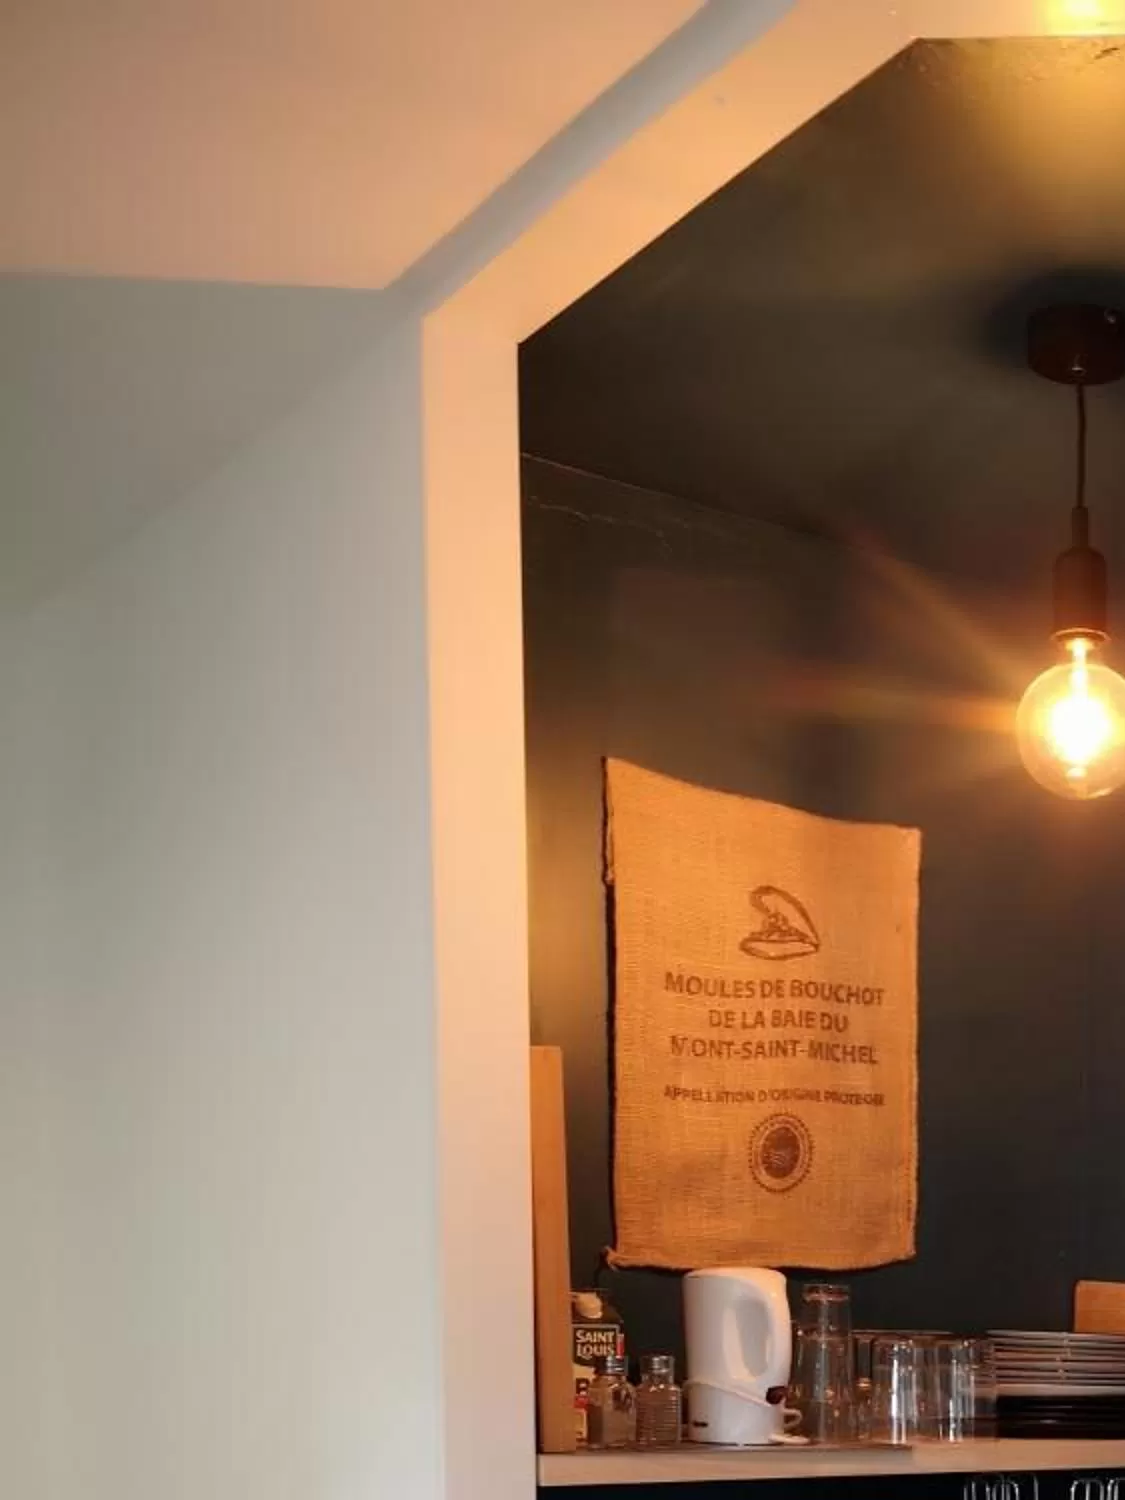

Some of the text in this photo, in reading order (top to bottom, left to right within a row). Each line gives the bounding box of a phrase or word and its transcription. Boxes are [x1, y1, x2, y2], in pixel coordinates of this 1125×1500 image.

[664, 971, 884, 1006] MOULES DE BOUCHOT
[708, 1009, 849, 1033] DE LA BAIE DU
[669, 1035, 879, 1065] MONT-SAINT-MICHEL
[575, 1329, 615, 1343] SAINT
[576, 1343, 615, 1360] LOUIS
